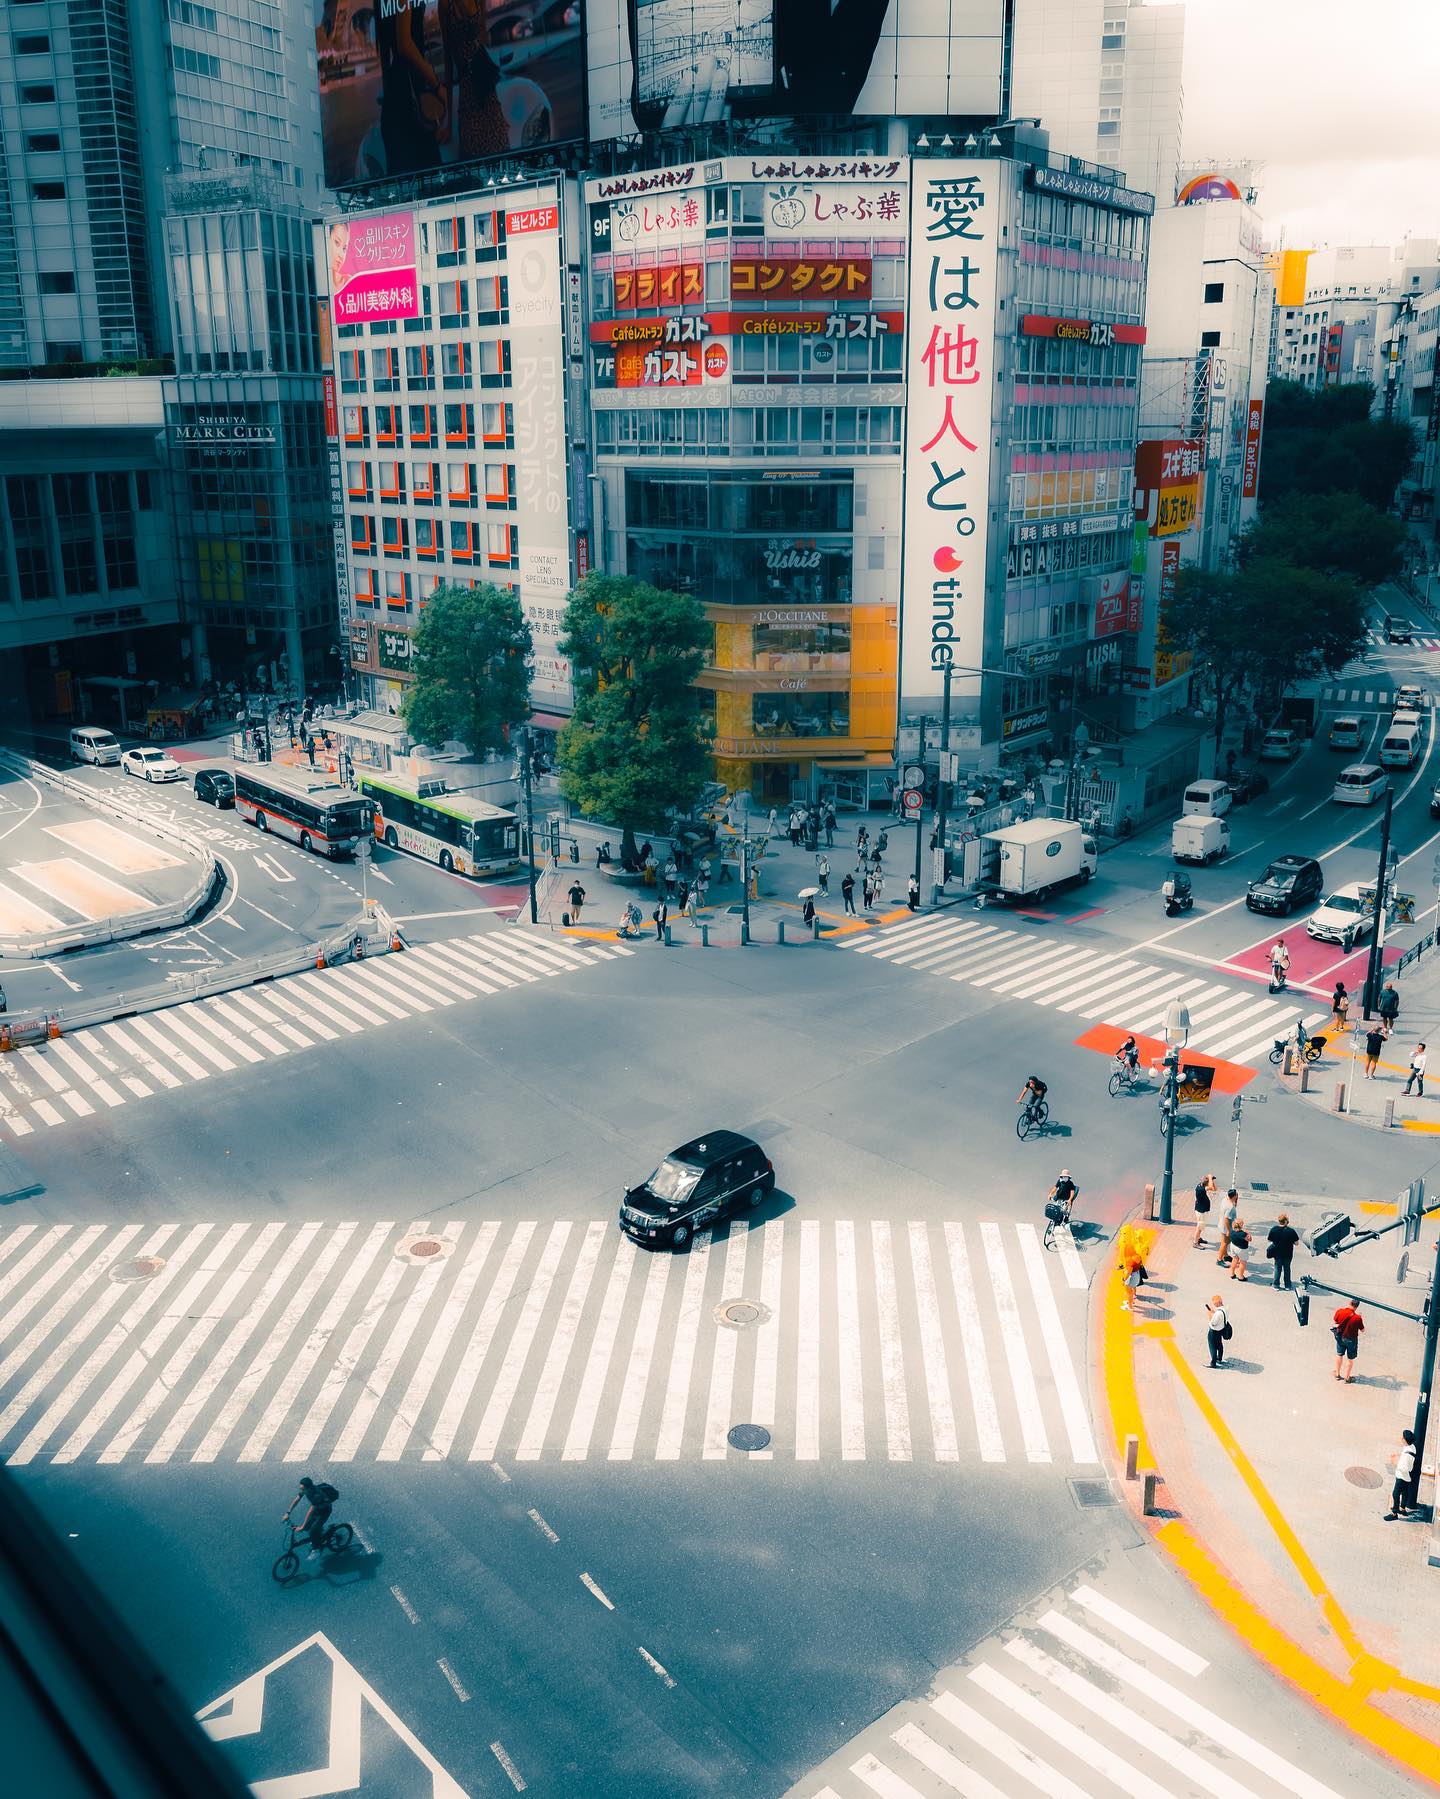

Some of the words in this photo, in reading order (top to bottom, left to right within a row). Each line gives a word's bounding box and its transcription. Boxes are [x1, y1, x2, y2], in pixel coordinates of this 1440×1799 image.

[752, 161, 900, 179] しゃぶしゃぶバイキング
[598, 168, 695, 198] しゃぶしゃぶバイキング
[643, 199, 699, 232] しゃぶ葉
[814, 191, 901, 222] しゃぶ葉
[510, 210, 553, 232] 当ビル5F
[594, 218, 610, 237] 9F
[366, 223, 410, 246] 品川スキン
[367, 242, 407, 263] クリニック
[615, 268, 703, 302] プライス
[732, 264, 867, 292] コンタクト
[345, 286, 414, 315] 品川美容外科
[665, 316, 709, 343] ガスト
[825, 314, 888, 339] ガスト
[1089, 322, 1115, 347] ガスト
[707, 357, 726, 369] ガスト
[920, 175, 985, 536] 愛は他人と。
[596, 357, 615, 377] 7F
[643, 350, 698, 384] ガスト
[199, 416, 247, 424] SHIBUYA
[176, 427, 226, 438] MARK
[233, 426, 276, 438] CITY
[1161, 447, 1200, 479] スギ薬局
[1121, 513, 1134, 529] 4F
[1159, 495, 1196, 527] 処方せん
[529, 555, 558, 565] CONTACT
[764, 550, 822, 568] Ushi8
[525, 574, 564, 586] SPECIALISTS
[536, 566, 552, 575] LENS
[759, 610, 828, 622] L'OCCITANE
[1086, 641, 1118, 668] LUSH
[780, 678, 808, 691] Café
